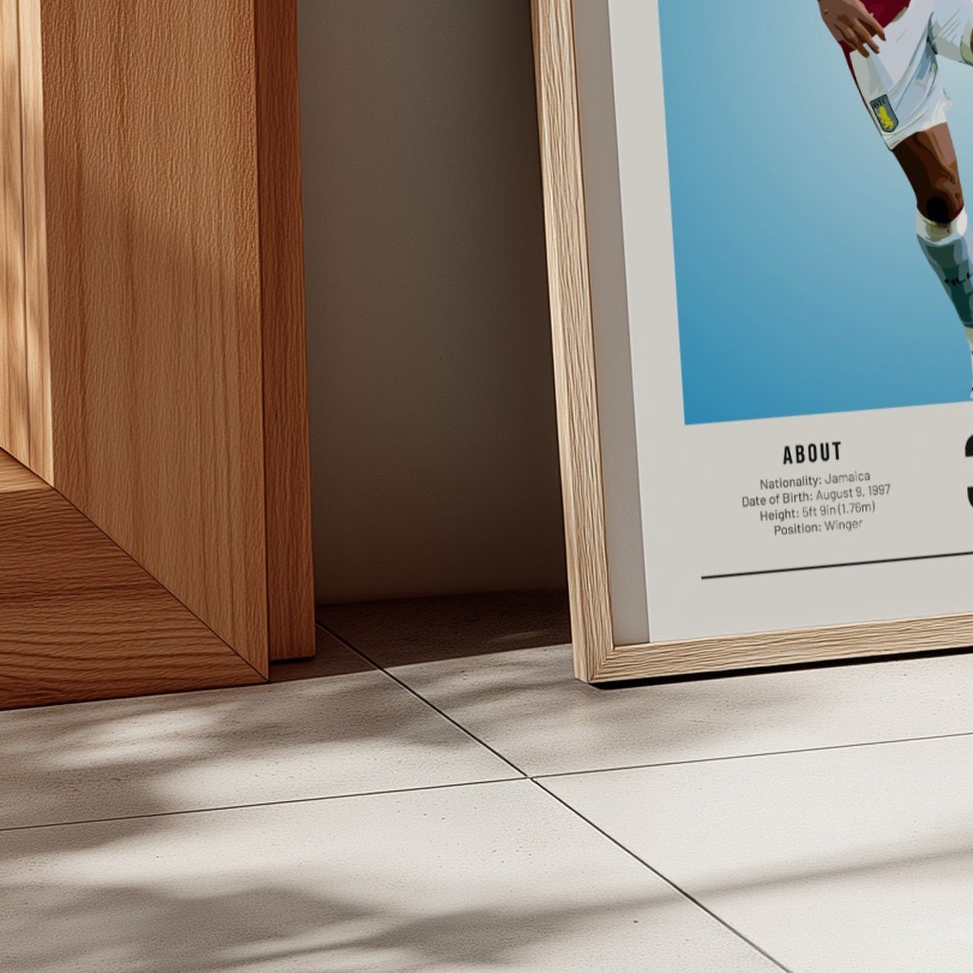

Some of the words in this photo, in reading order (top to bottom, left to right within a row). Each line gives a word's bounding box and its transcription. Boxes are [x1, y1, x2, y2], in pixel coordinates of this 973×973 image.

[782, 441, 842, 465] ABOUT
[760, 475, 822, 490] Nationality:
[824, 471, 871, 484] Jamaica
[742, 495, 766, 508] Date
[769, 494, 780, 505] of
[782, 491, 813, 504] Birth:
[816, 488, 853, 502] August
[868, 483, 891, 496] 1997
[760, 508, 799, 522] Height:
[802, 506, 818, 518] 5ft
[774, 522, 822, 536] Position:
[824, 519, 863, 532] Winger
